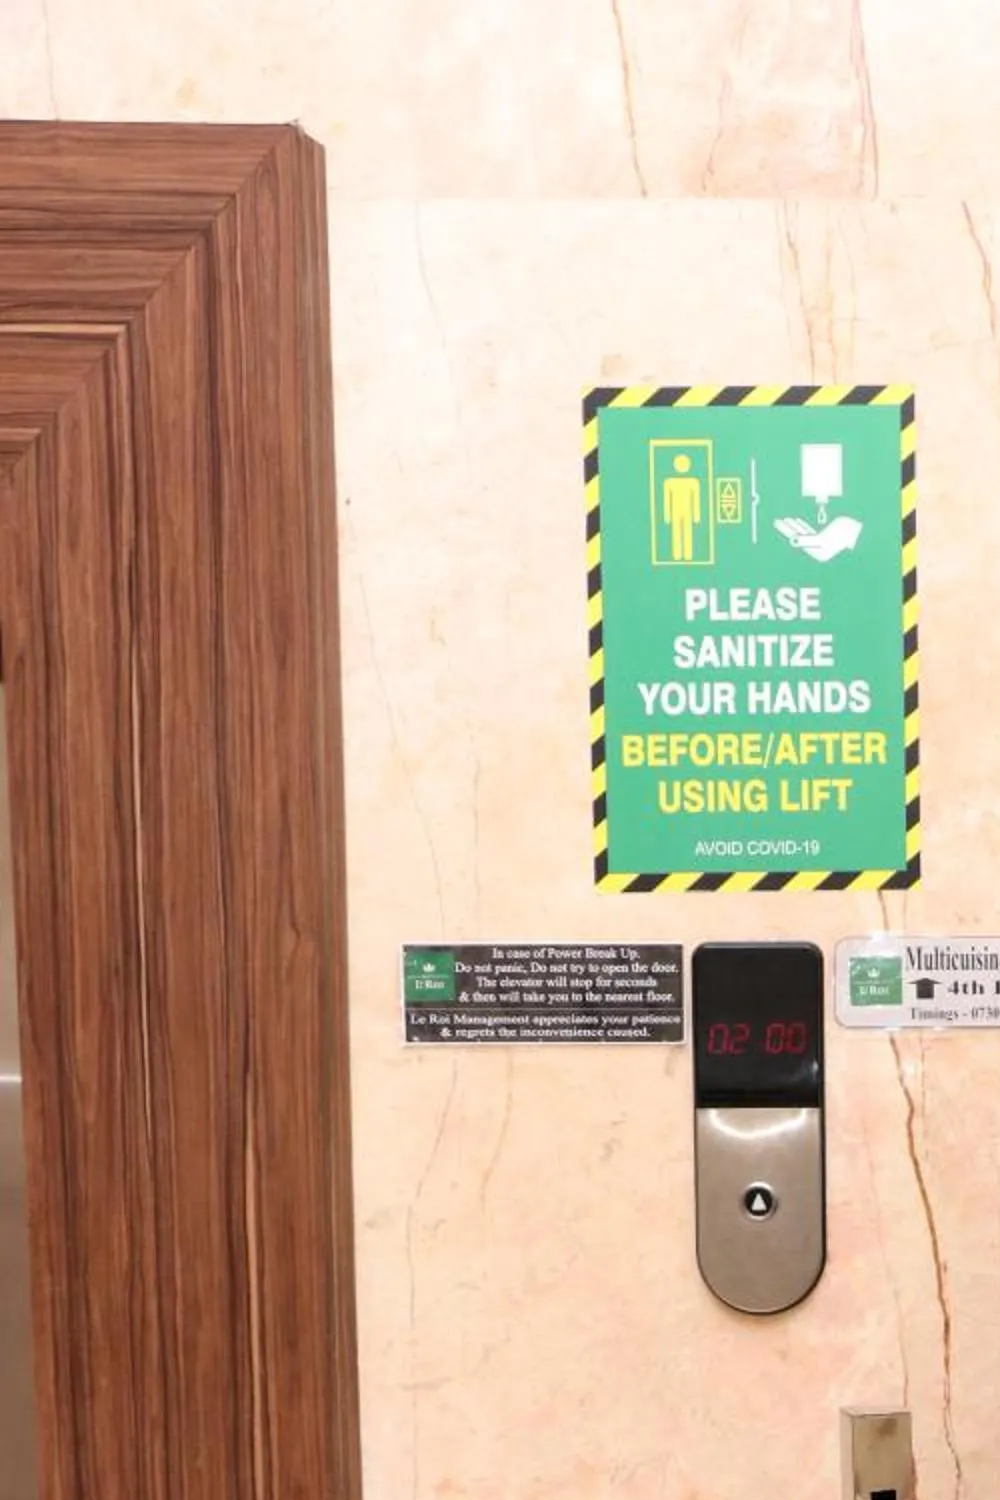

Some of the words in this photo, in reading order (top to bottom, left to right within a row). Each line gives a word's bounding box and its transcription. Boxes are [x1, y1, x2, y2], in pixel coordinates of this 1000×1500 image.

[685, 588, 821, 621] PLEASE
[673, 634, 835, 668] SANITIZE
[638, 683, 736, 716] YOUR
[748, 680, 871, 714] HANDS
[621, 731, 888, 768] BEFORE/AFTER
[658, 781, 768, 814] USING
[780, 779, 853, 811] LIFT
[694, 841, 743, 857] AVOID
[747, 839, 820, 857] COVID-19
[492, 948, 505, 959] In
[506, 950, 531, 960] case
[533, 948, 546, 959] of
[547, 948, 583, 960] Power
[585, 948, 616, 959] Break
[620, 948, 640, 962] Up.
[455, 962, 472, 973] Do
[474, 963, 492, 974] not
[494, 962, 527, 975] panic,
[530, 962, 548, 973] Do
[550, 963, 568, 974] not
[570, 963, 585, 975] try
[588, 963, 600, 974] to
[601, 964, 629, 976] open
[631, 962, 650, 973] the
[651, 962, 680, 973] door.
[476, 977, 498, 988] The
[499, 977, 543, 988] elevator
[545, 976, 567, 987] will
[570, 977, 593, 989] stop
[595, 976, 612, 988] for
[614, 976, 657, 988] seconds
[947, 979, 985, 996] 4th
[459, 992, 470, 1002] &
[471, 991, 497, 1002] then
[498, 991, 520, 1002] will
[523, 991, 545, 1002] take
[548, 993, 569, 1004] you
[571, 992, 584, 1002] to
[585, 991, 603, 1002] the
[604, 991, 644, 1002] nearest
[646, 990, 675, 1002] floor.
[410, 1013, 428, 1025] Le
[429, 1013, 450, 1025] Roi
[452, 1013, 530, 1027] Management
[533, 1014, 598, 1027] appreciates
[601, 1015, 628, 1027] your
[631, 1014, 681, 1026] patience
[911, 1006, 960, 1021] Timings
[970, 1007, 1000, 1020] 0730
[440, 1027, 453, 1038] &
[455, 1028, 496, 1039] regrets
[498, 1026, 517, 1037] the
[519, 1026, 604, 1038] inconvenience
[765, 1022, 807, 1054] 00
